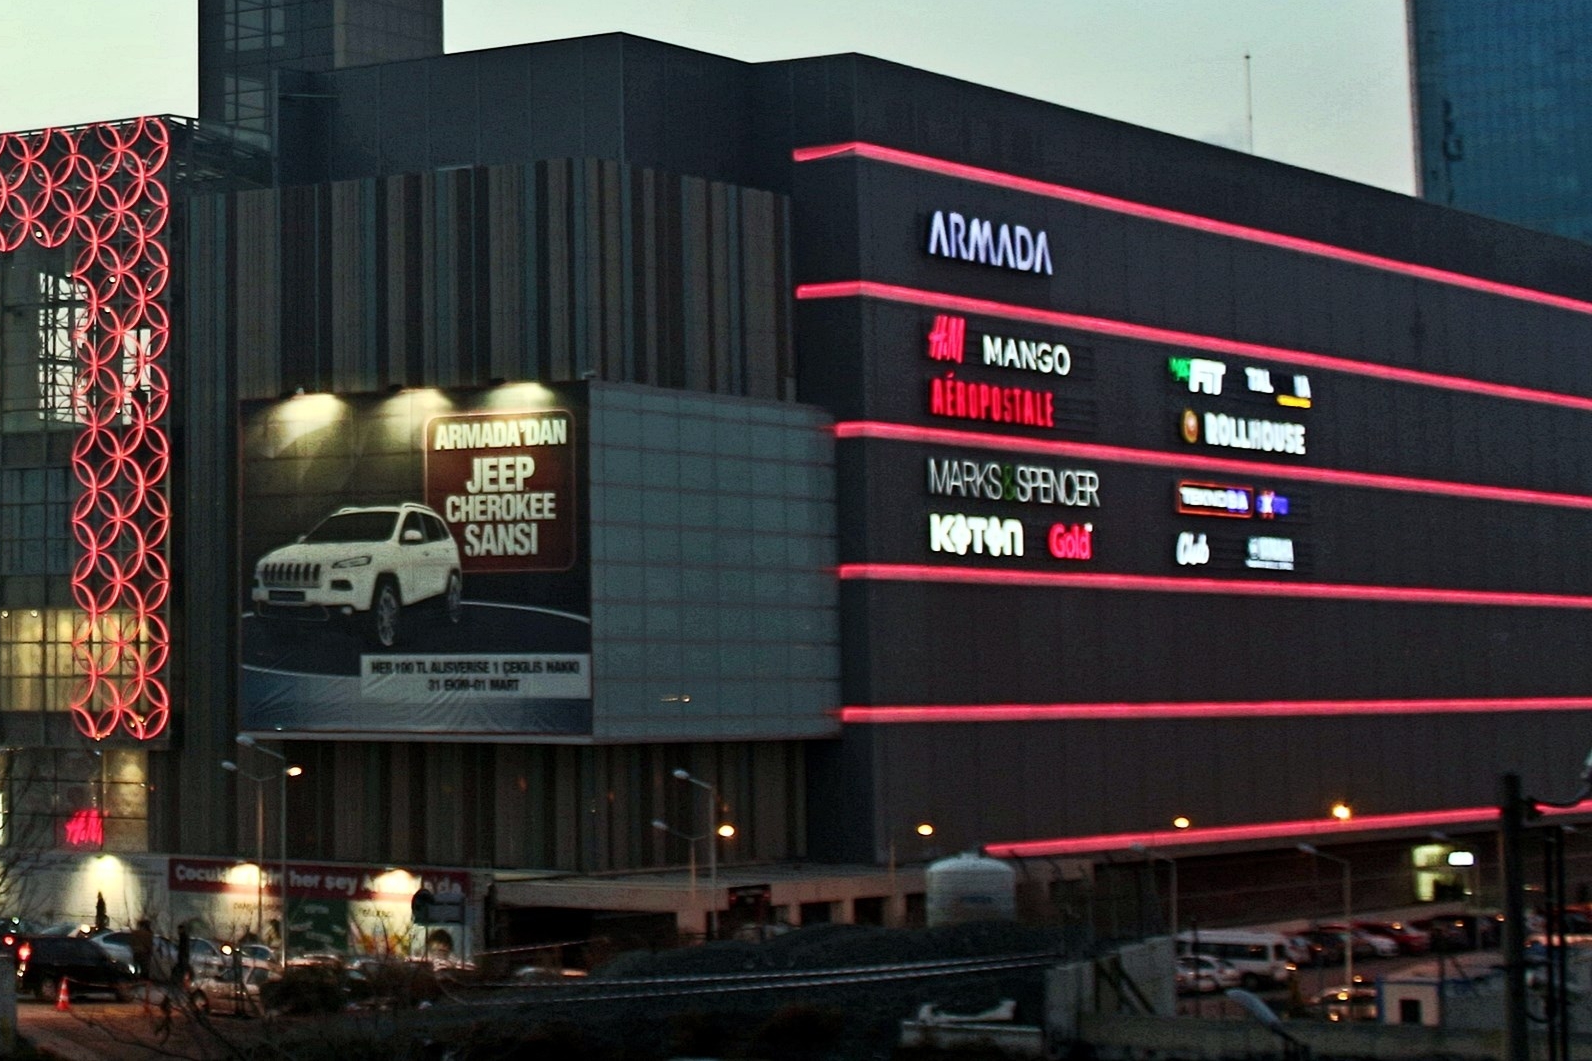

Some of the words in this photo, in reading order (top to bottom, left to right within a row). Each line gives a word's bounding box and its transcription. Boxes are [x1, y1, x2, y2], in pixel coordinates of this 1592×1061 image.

[929, 210, 1053, 275] ARMADA
[982, 334, 1071, 376] MANGO
[434, 419, 567, 451] ARMADA'DAN
[1204, 411, 1306, 455] ROLLHOUSE
[466, 456, 536, 494] JEEP
[445, 493, 557, 523] CHEROKEE
[1048, 522, 1094, 560] Gold
